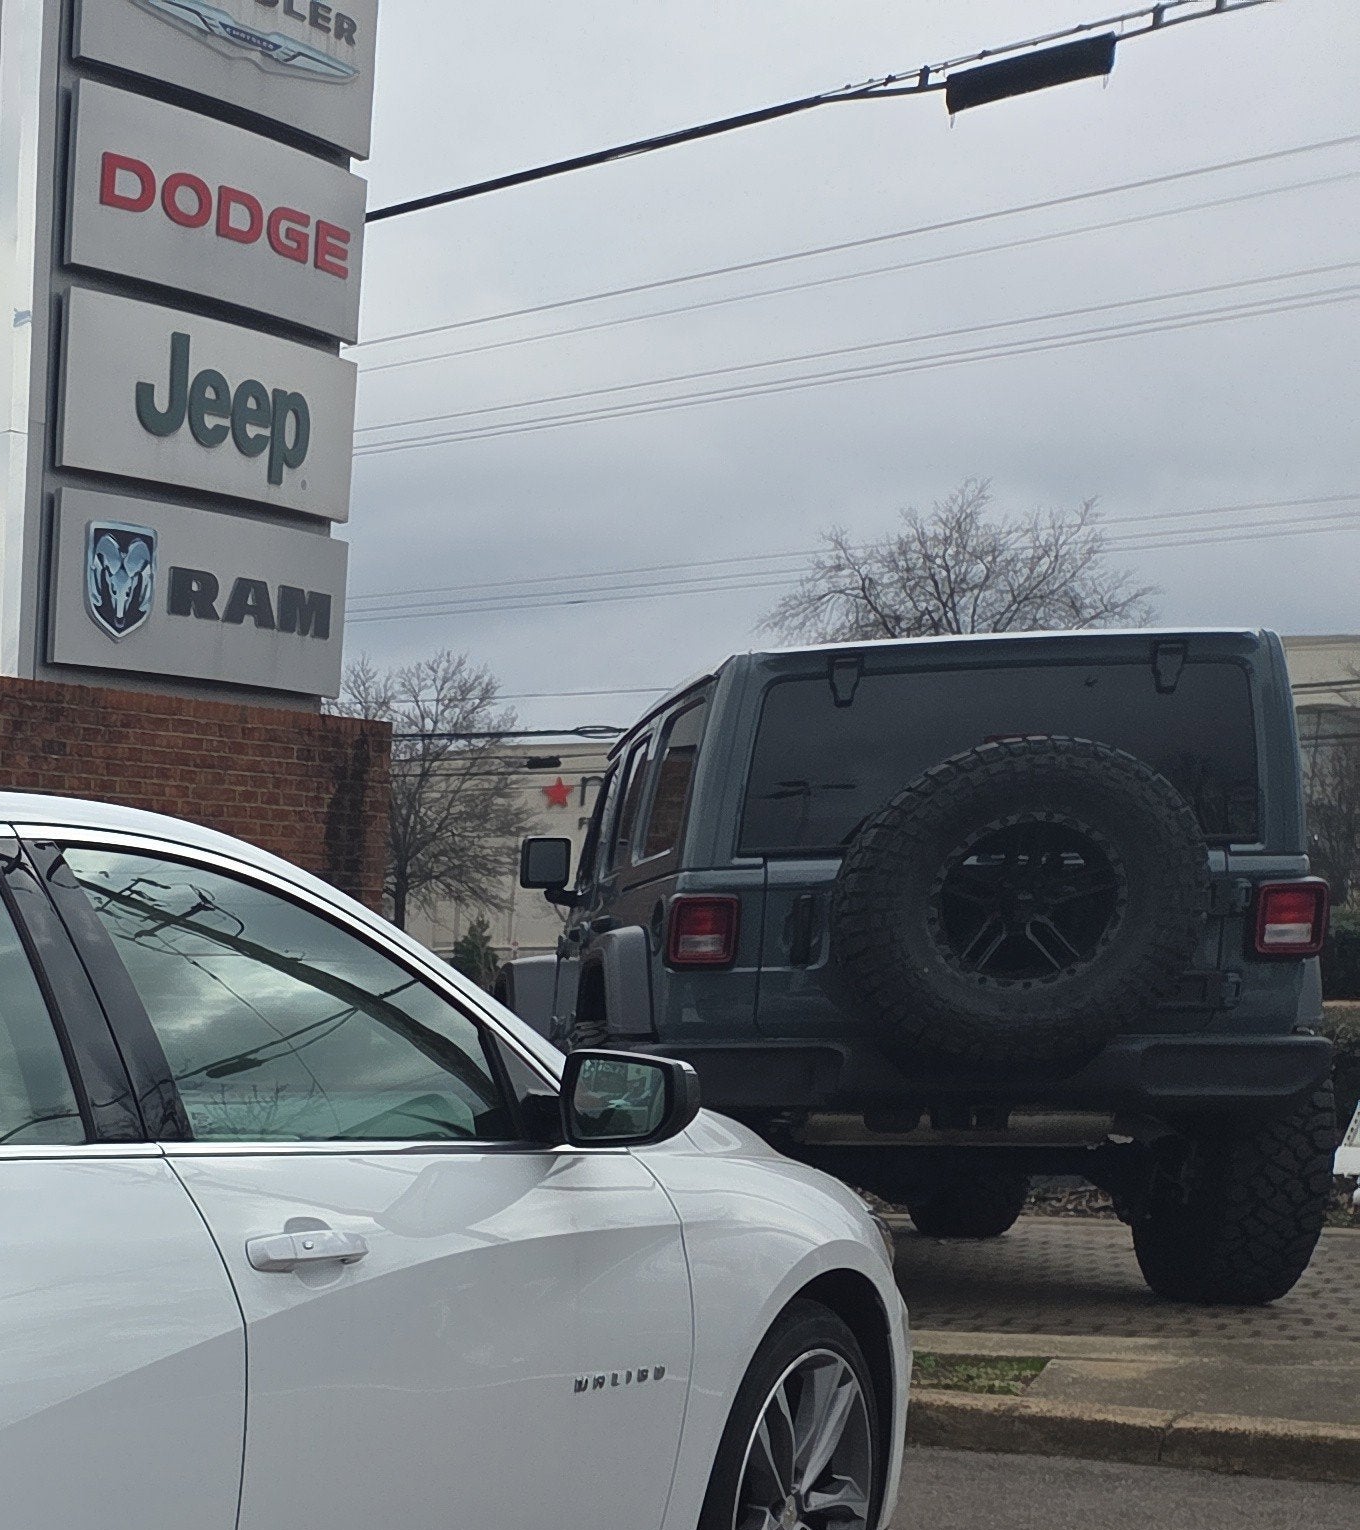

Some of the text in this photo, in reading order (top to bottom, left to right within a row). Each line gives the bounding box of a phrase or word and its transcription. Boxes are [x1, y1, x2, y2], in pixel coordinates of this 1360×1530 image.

[99, 151, 351, 280] DODGE
[135, 331, 311, 486] Jeep
[167, 566, 332, 640] RAM
[573, 1365, 666, 1394] MALIBU
